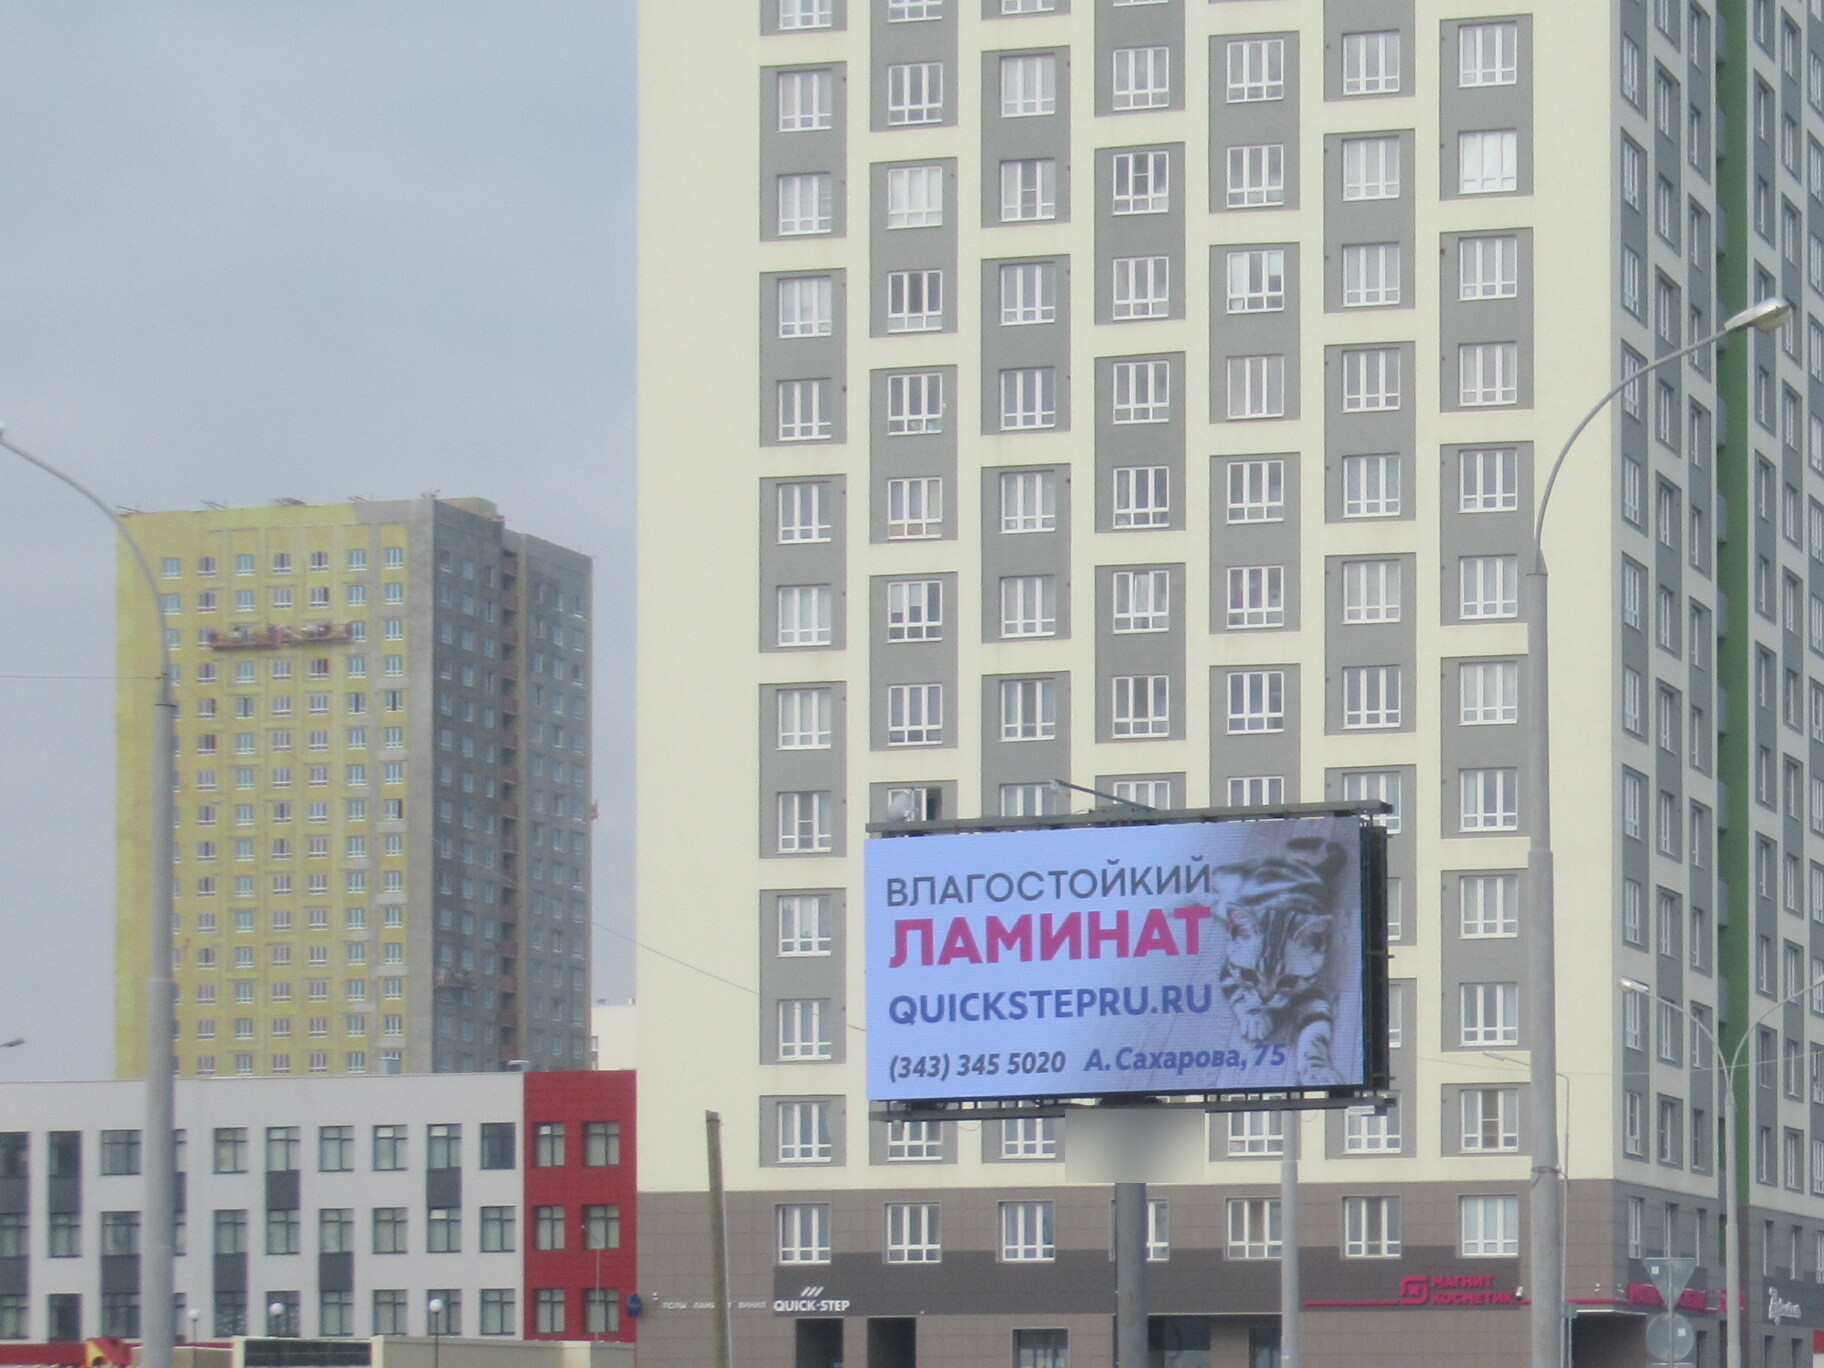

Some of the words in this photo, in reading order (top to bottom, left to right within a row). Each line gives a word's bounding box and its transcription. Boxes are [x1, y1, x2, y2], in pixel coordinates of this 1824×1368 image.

[887, 855, 1211, 907] ВЛАГОСТОЙКИЙ
[889, 906, 1212, 968] ЛАМИНАТ
[889, 984, 1212, 1026] QUICKSTEPRU.RU
[889, 1053, 950, 1082] (343)
[957, 1053, 1000, 1077] 345
[1007, 1050, 1066, 1075] 5020
[1254, 1043, 1287, 1066] 75
